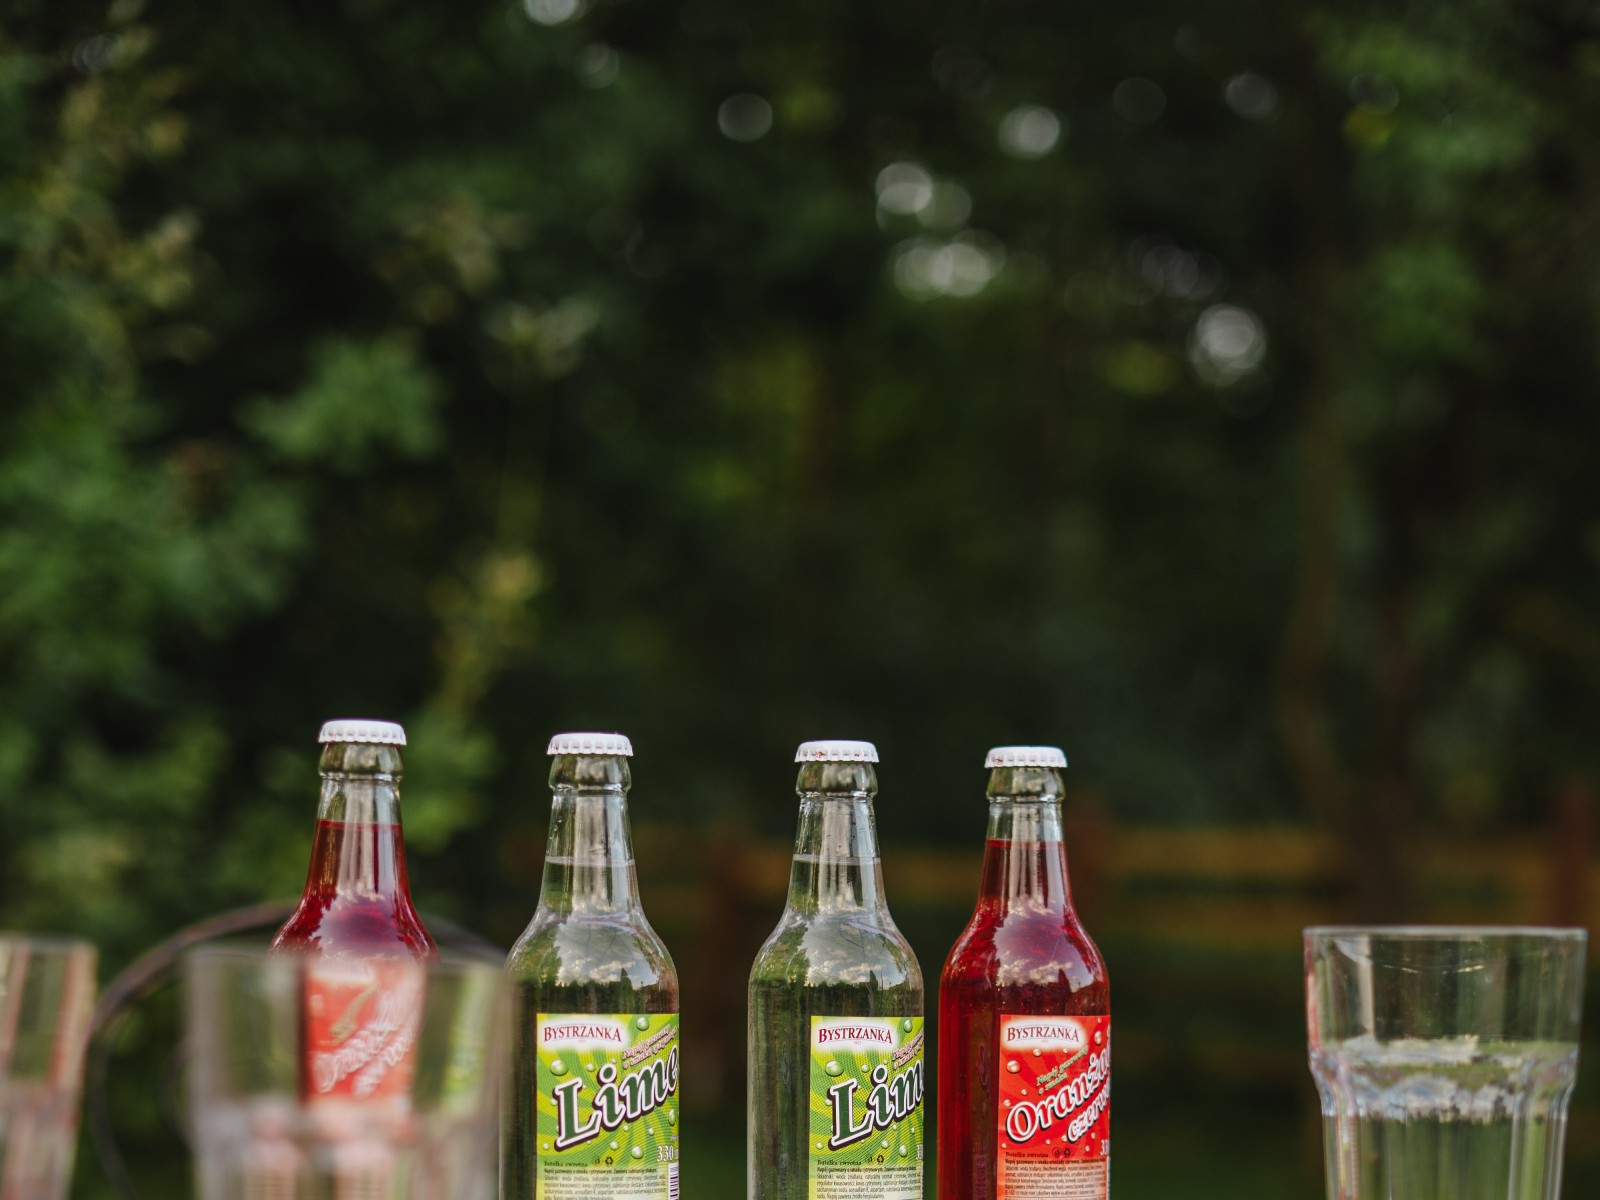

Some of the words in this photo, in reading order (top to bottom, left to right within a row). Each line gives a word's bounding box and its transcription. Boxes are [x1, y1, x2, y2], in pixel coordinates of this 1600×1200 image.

[544, 1026, 622, 1042] BYSTRZANKA
[818, 1028, 892, 1044] BYSTRZANKA
[1007, 1026, 1079, 1043] BYSTRZANKA
[828, 1059, 924, 1151] Lim
[656, 1145, 674, 1162] 330
